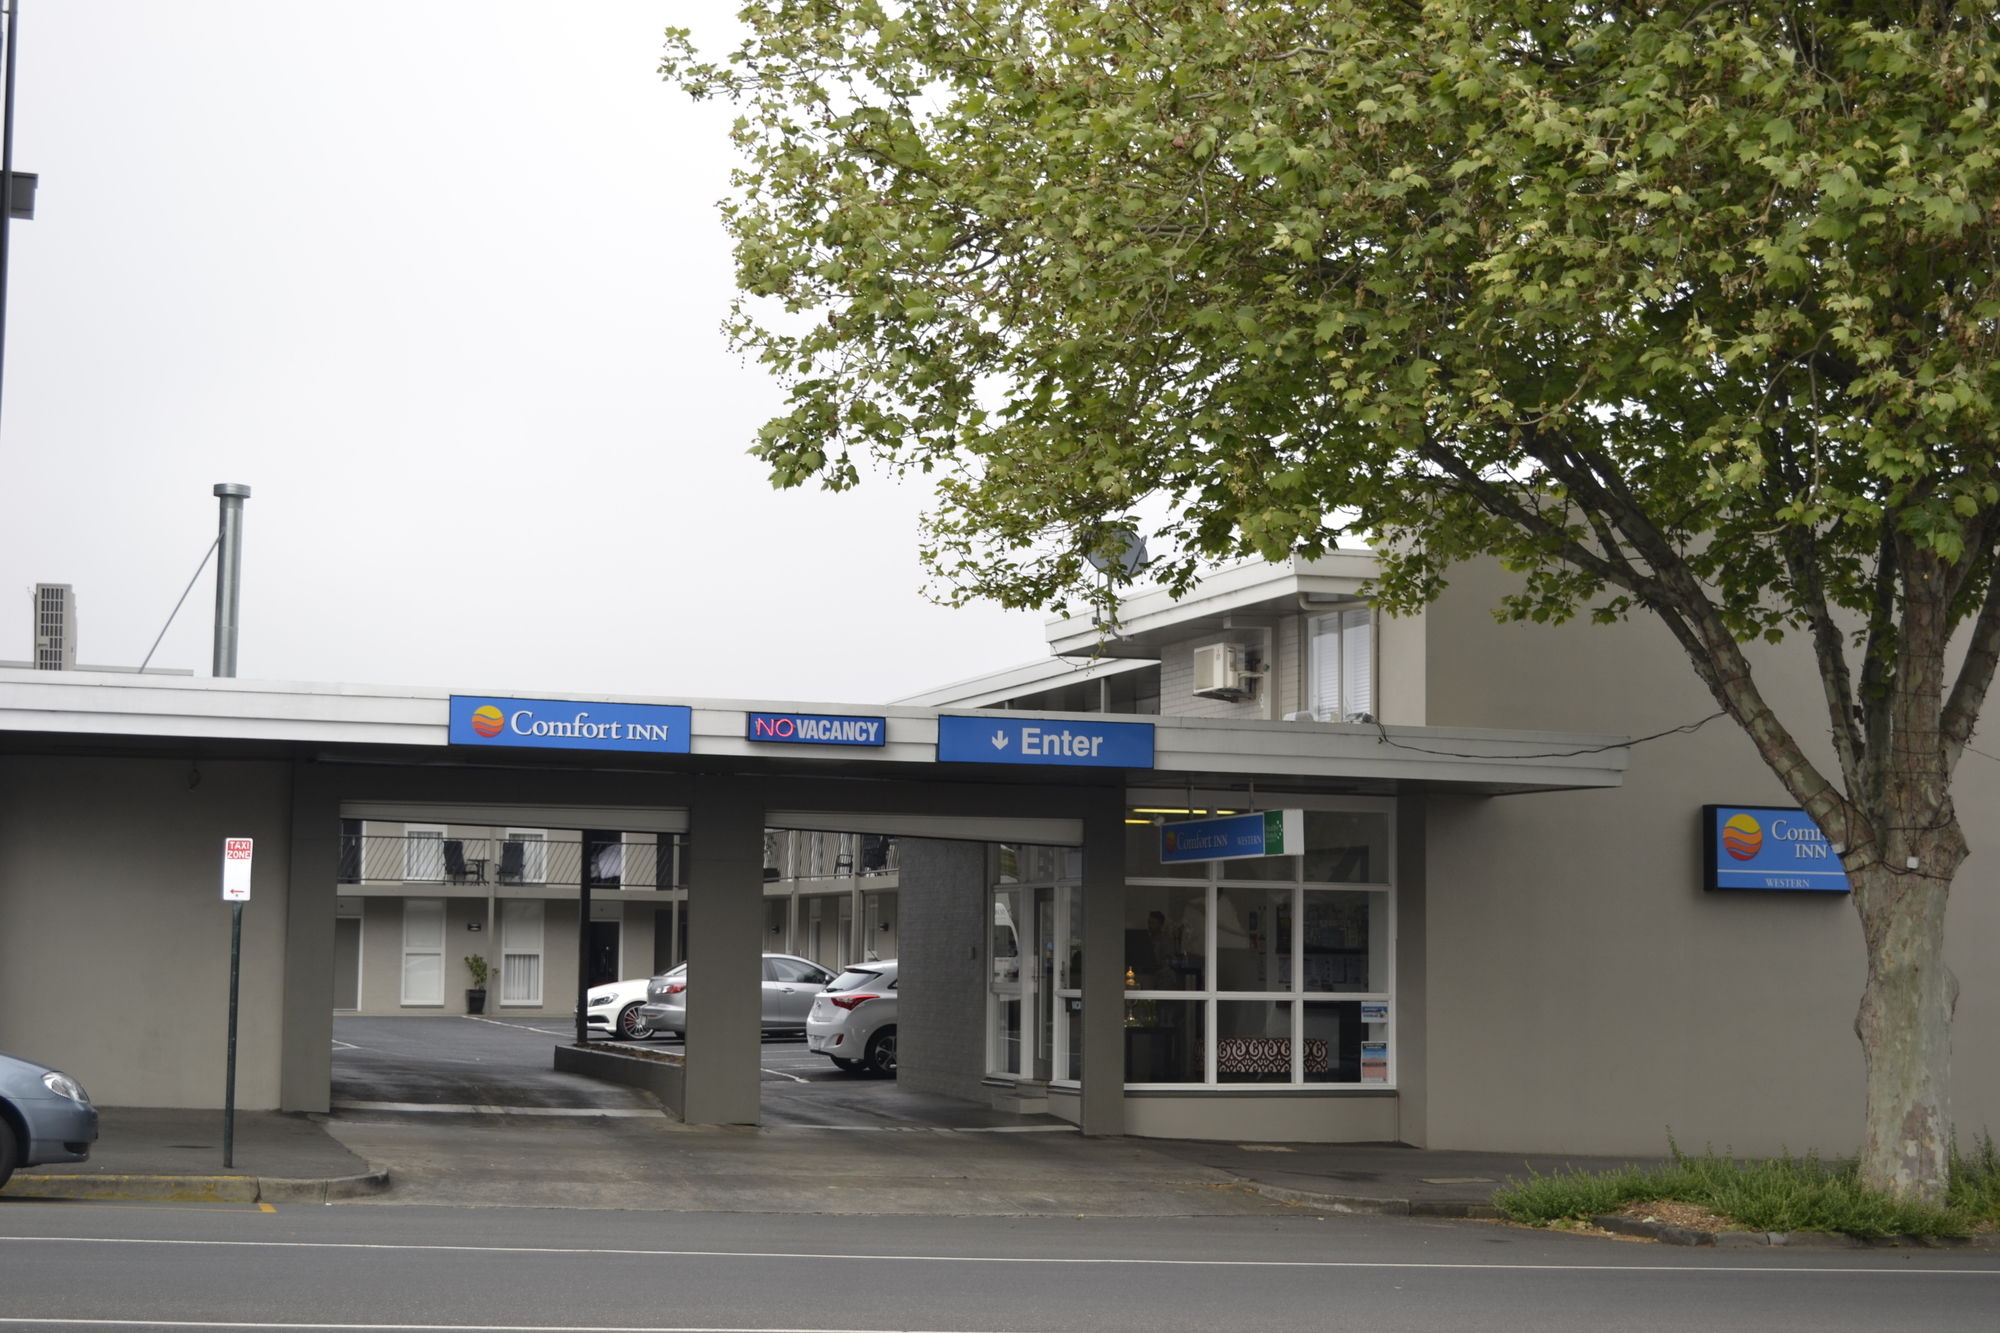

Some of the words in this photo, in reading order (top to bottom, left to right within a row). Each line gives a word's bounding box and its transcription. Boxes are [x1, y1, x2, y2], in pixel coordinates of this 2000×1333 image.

[511, 710, 622, 739] Comfort
[626, 723, 669, 741] INN
[756, 718, 794, 737] NO
[796, 719, 879, 742] VACANCY
[1022, 727, 1103, 757] Enter
[1177, 829, 1212, 851] Comfort
[1771, 819, 1826, 841] Comf
[227, 850, 250, 859] ZONE
[228, 841, 250, 850] TAXI
[1795, 843, 1827, 859] INN
[1765, 878, 1811, 888] WESTERN
